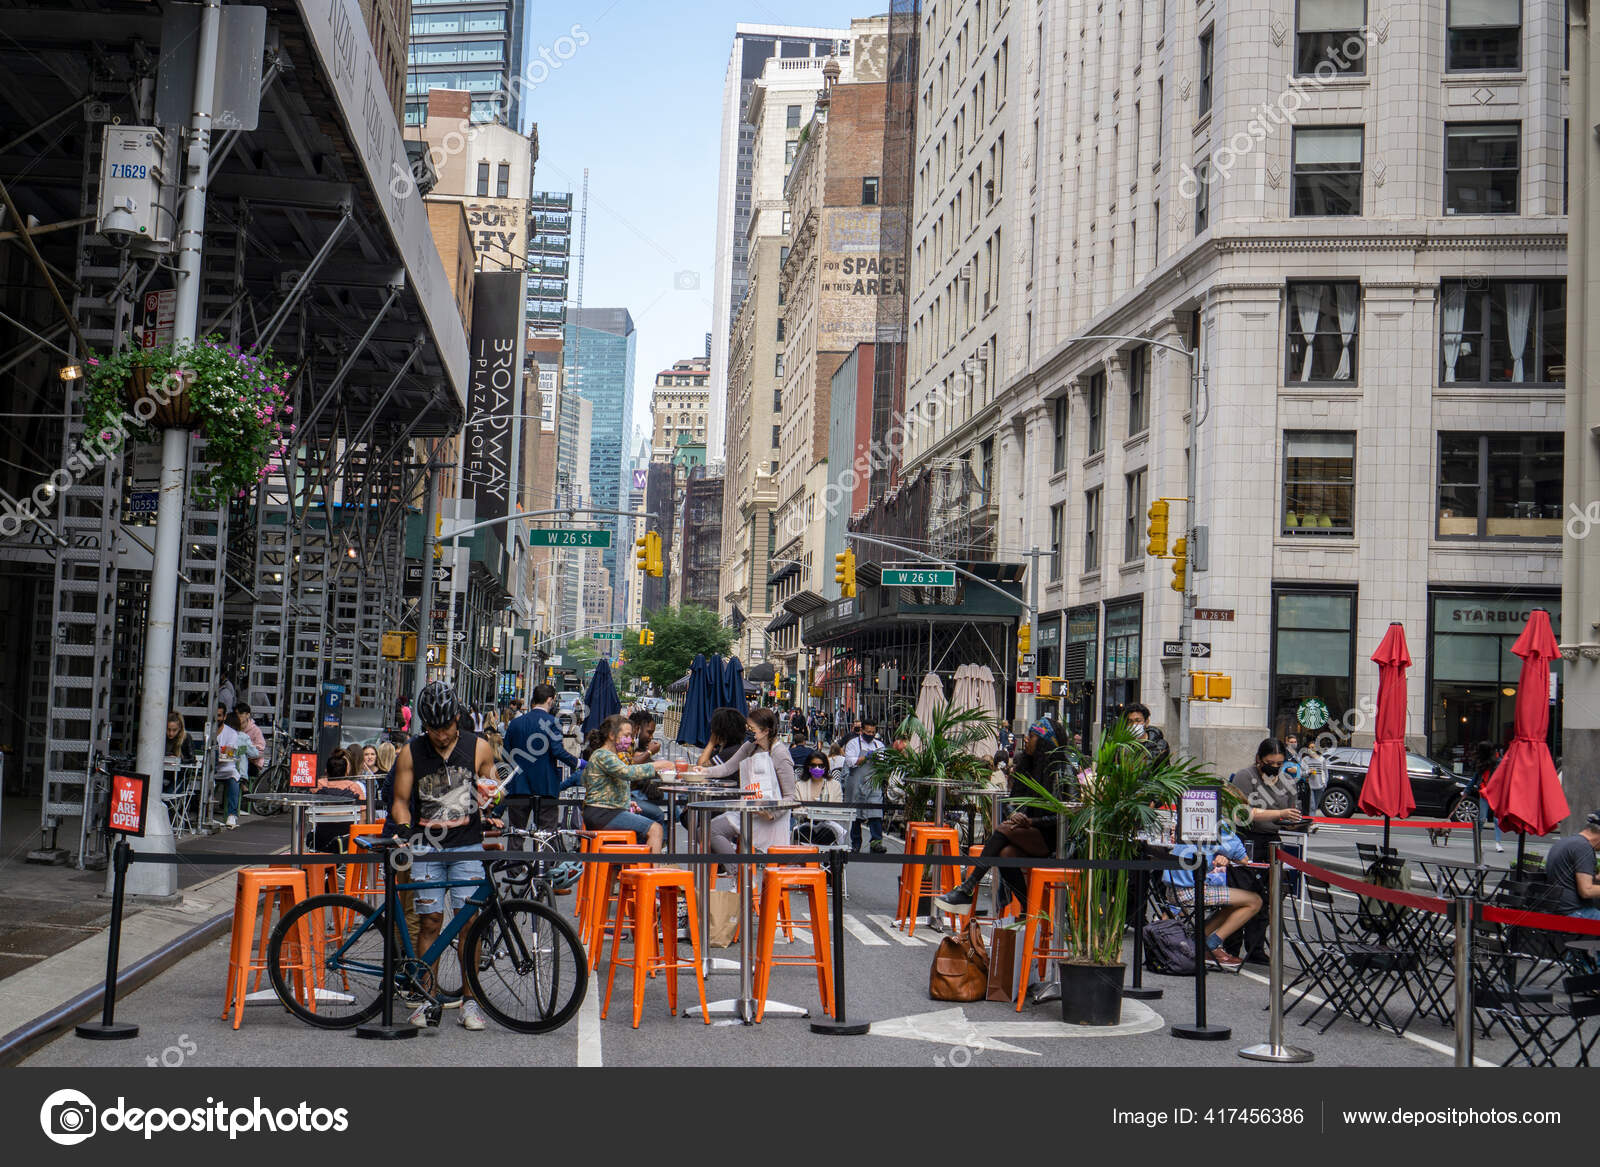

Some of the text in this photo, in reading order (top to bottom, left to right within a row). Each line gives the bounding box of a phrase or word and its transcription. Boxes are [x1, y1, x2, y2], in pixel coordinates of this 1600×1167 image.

[823, 257, 905, 275] FOR SPACE
[821, 278, 904, 296] IN THIS AREA
[470, 359, 488, 482] PLAZA HOTEL
[486, 339, 514, 501] BROADWAY
[548, 532, 592, 545] W 26 St
[898, 572, 938, 583] W 26 St
[1201, 611, 1208, 619] W
[1452, 608, 1551, 622] STARBUC
[298, 760, 309, 768] WE
[296, 767, 310, 776] ARE
[292, 775, 313, 784] OPEN!
[120, 789, 135, 802] WE
[1183, 791, 1217, 799] NOTICE
[117, 801, 137, 815] ARE
[112, 812, 140, 829] OPEN!
